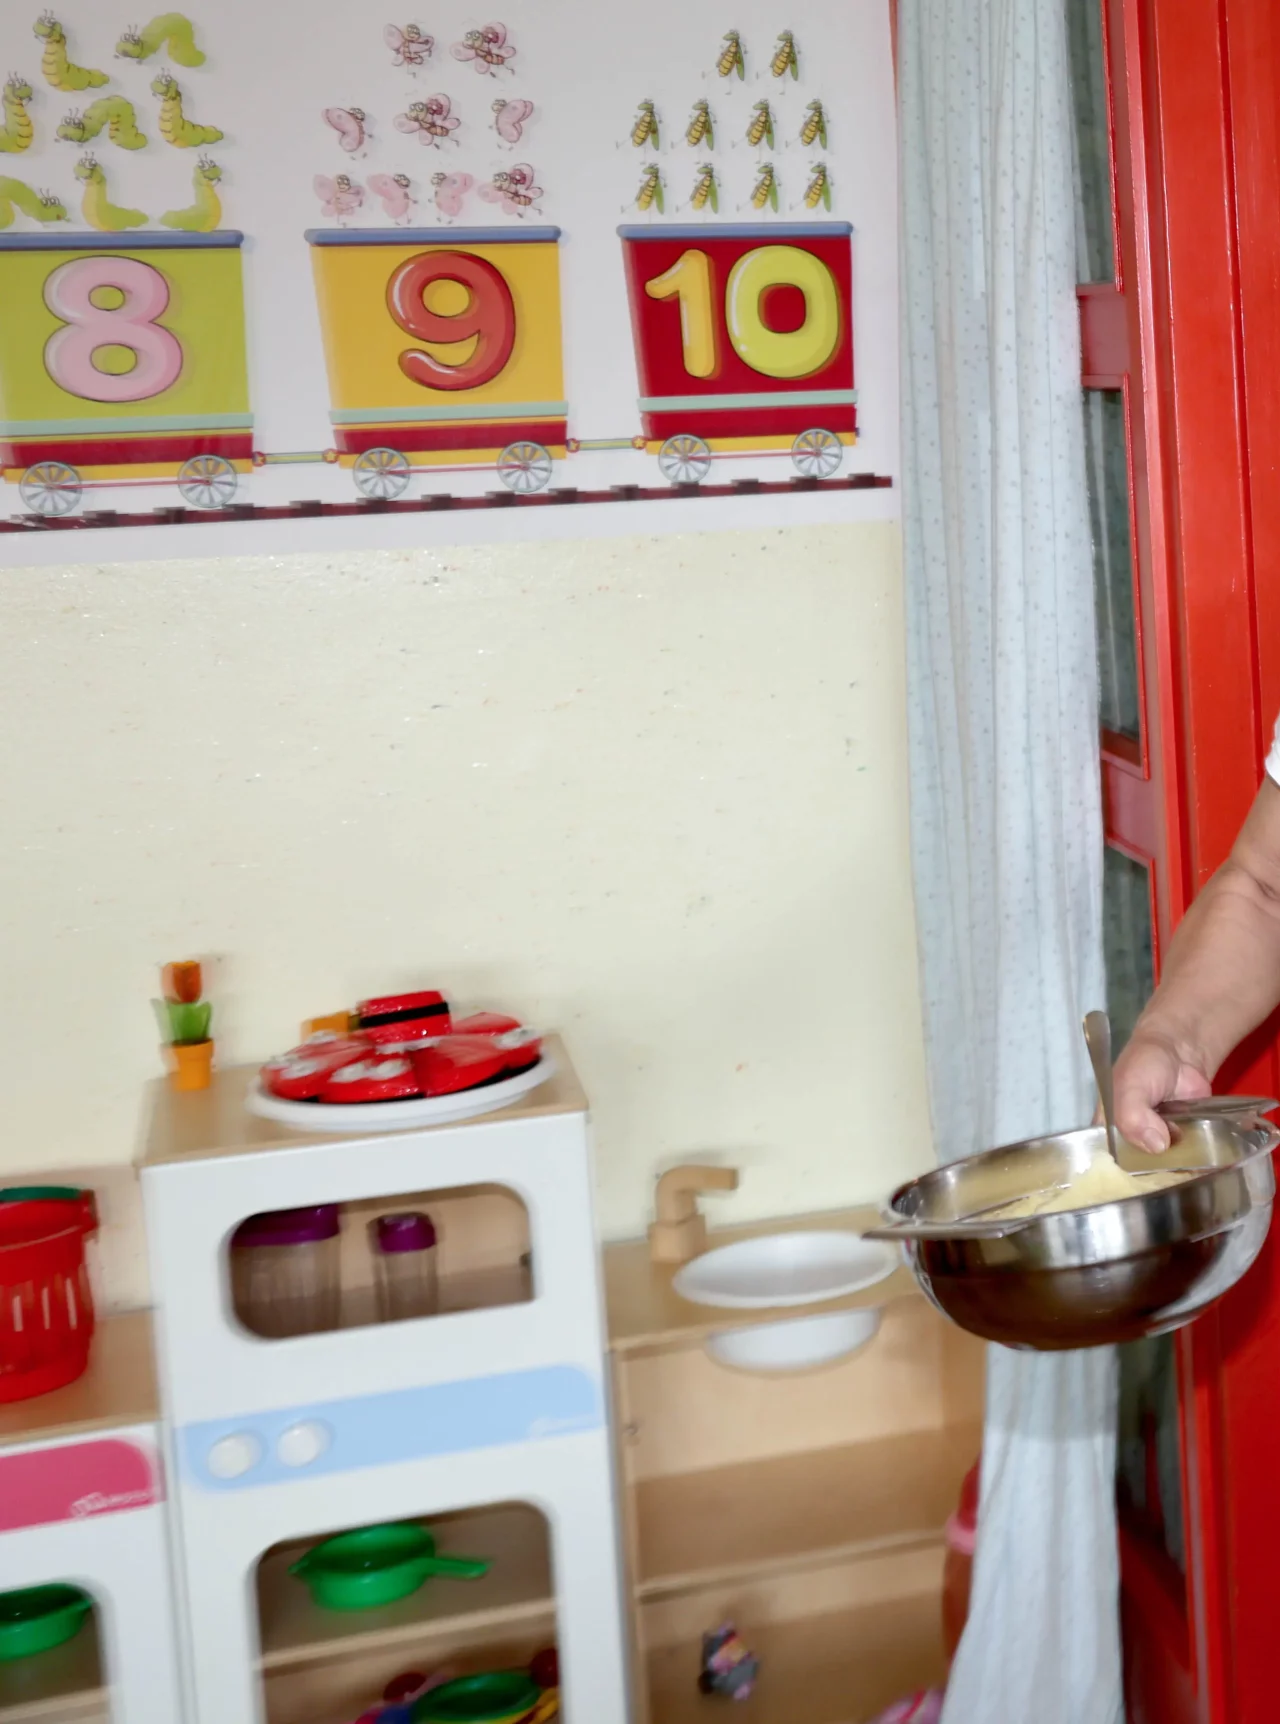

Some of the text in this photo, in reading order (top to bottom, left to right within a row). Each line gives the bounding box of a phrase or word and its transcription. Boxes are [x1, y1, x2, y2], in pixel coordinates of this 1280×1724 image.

[43, 254, 184, 403] 8
[386, 249, 516, 392] 9
[645, 244, 843, 380] 10
